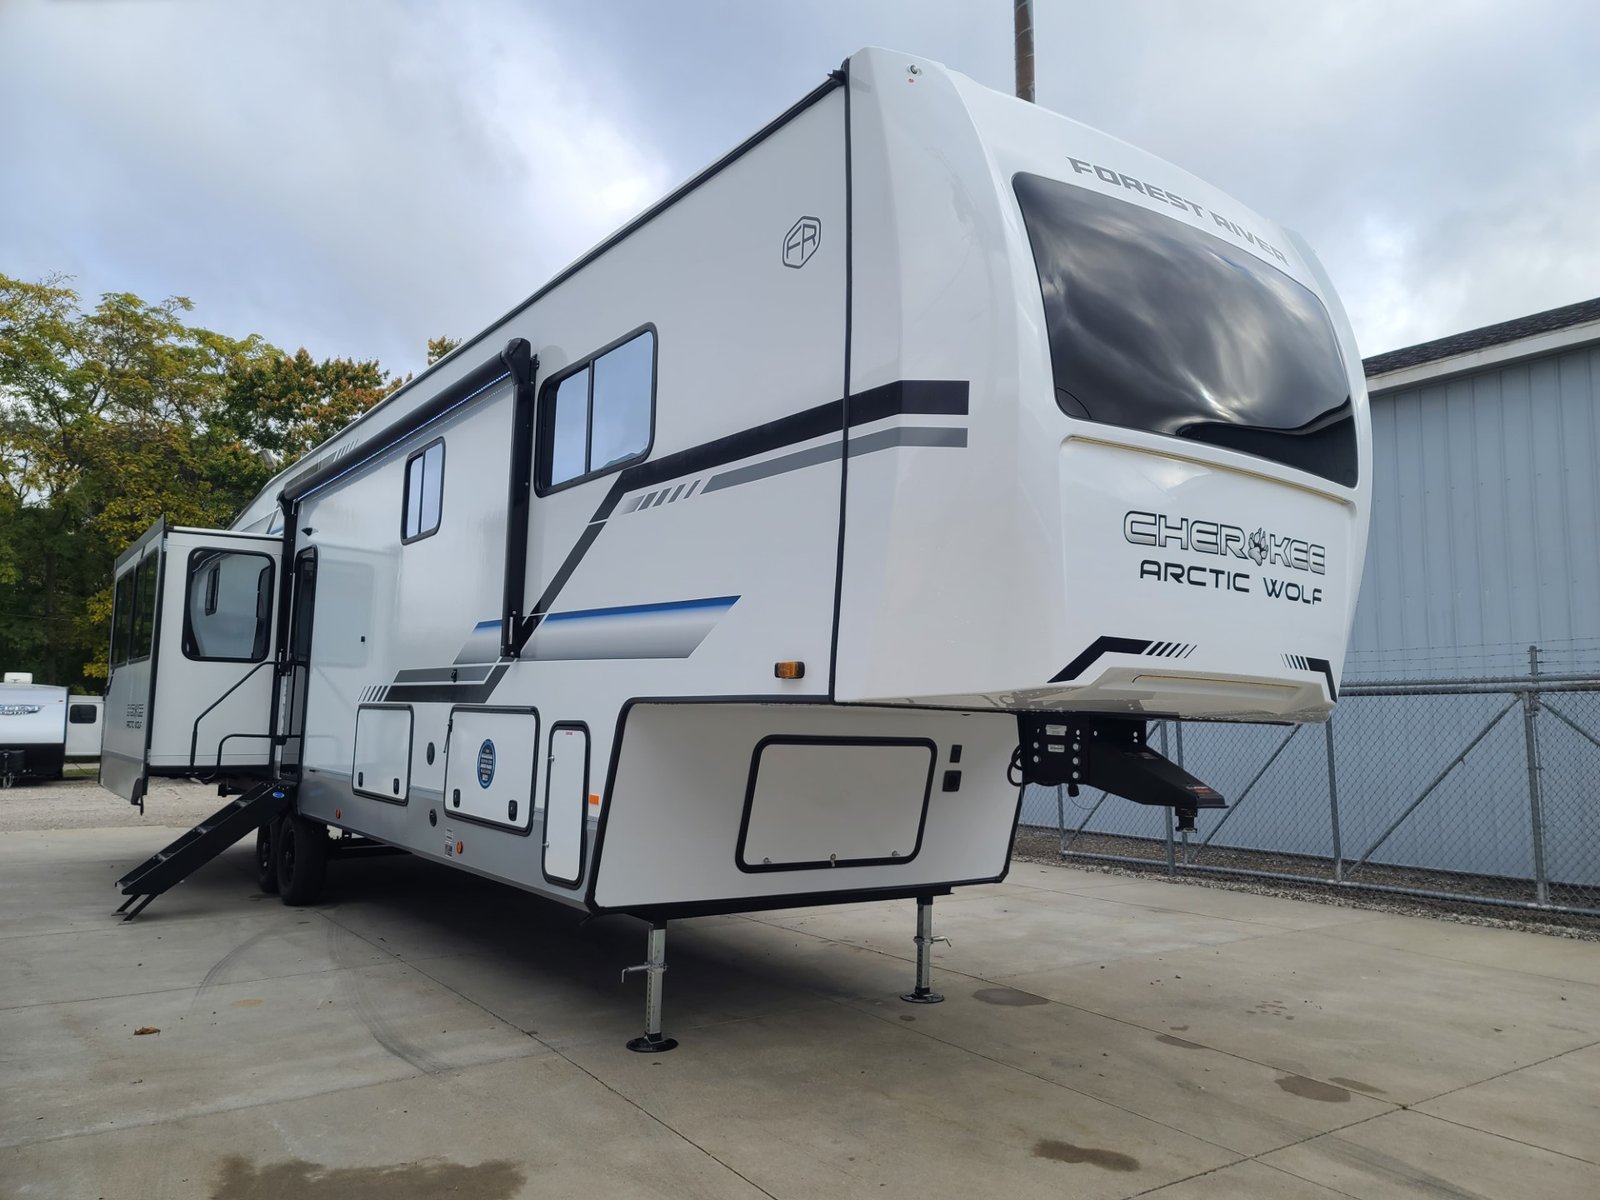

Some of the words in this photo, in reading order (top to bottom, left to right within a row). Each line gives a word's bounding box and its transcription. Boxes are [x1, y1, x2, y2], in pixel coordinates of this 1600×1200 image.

[1065, 156, 1204, 218] FOREST
[1208, 210, 1290, 267] RIVER
[1139, 559, 1250, 593] ARCTIC
[1262, 576, 1323, 605] WOLF
